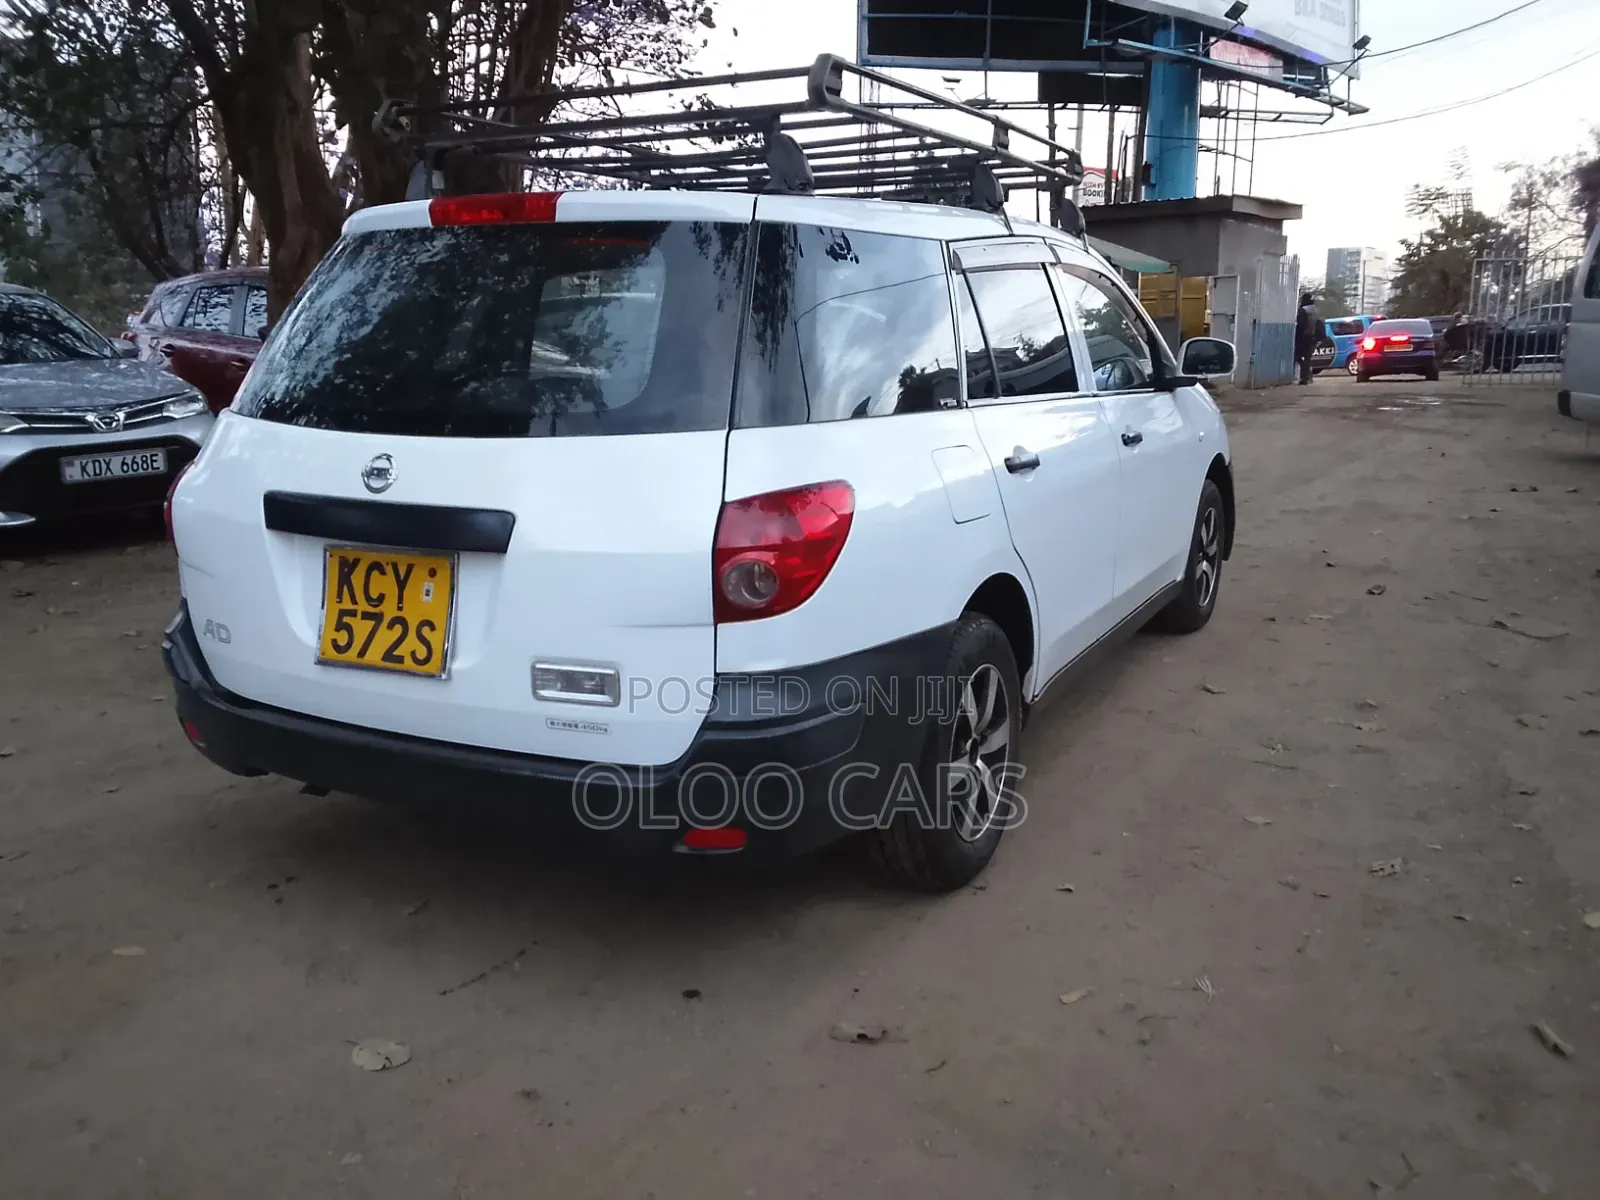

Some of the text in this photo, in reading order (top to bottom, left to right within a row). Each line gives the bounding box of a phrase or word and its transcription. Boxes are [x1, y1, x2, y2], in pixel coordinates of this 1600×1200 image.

[80, 453, 162, 479] KDX 668E
[335, 555, 415, 612] KCY
[202, 618, 232, 645] AD
[330, 608, 437, 667] 572S
